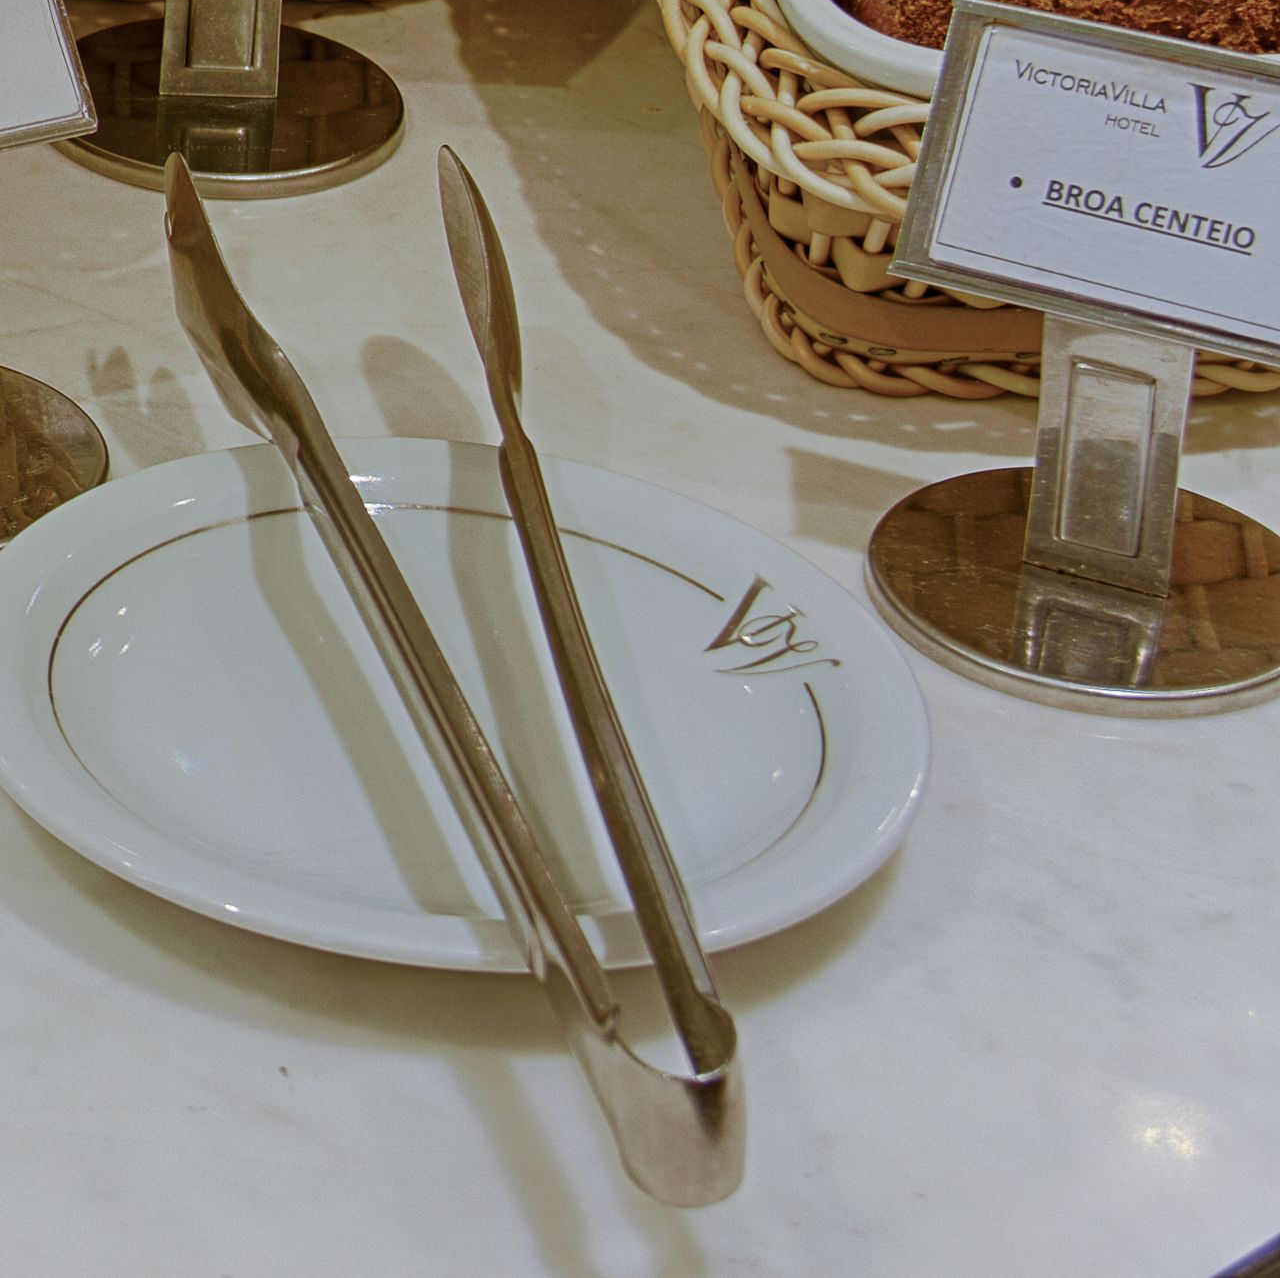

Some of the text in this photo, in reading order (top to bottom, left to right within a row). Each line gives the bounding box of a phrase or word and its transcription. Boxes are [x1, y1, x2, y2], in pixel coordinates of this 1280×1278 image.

[1106, 115, 1160, 138] HOTEL
[1044, 180, 1255, 250] BROA CENTEIO
